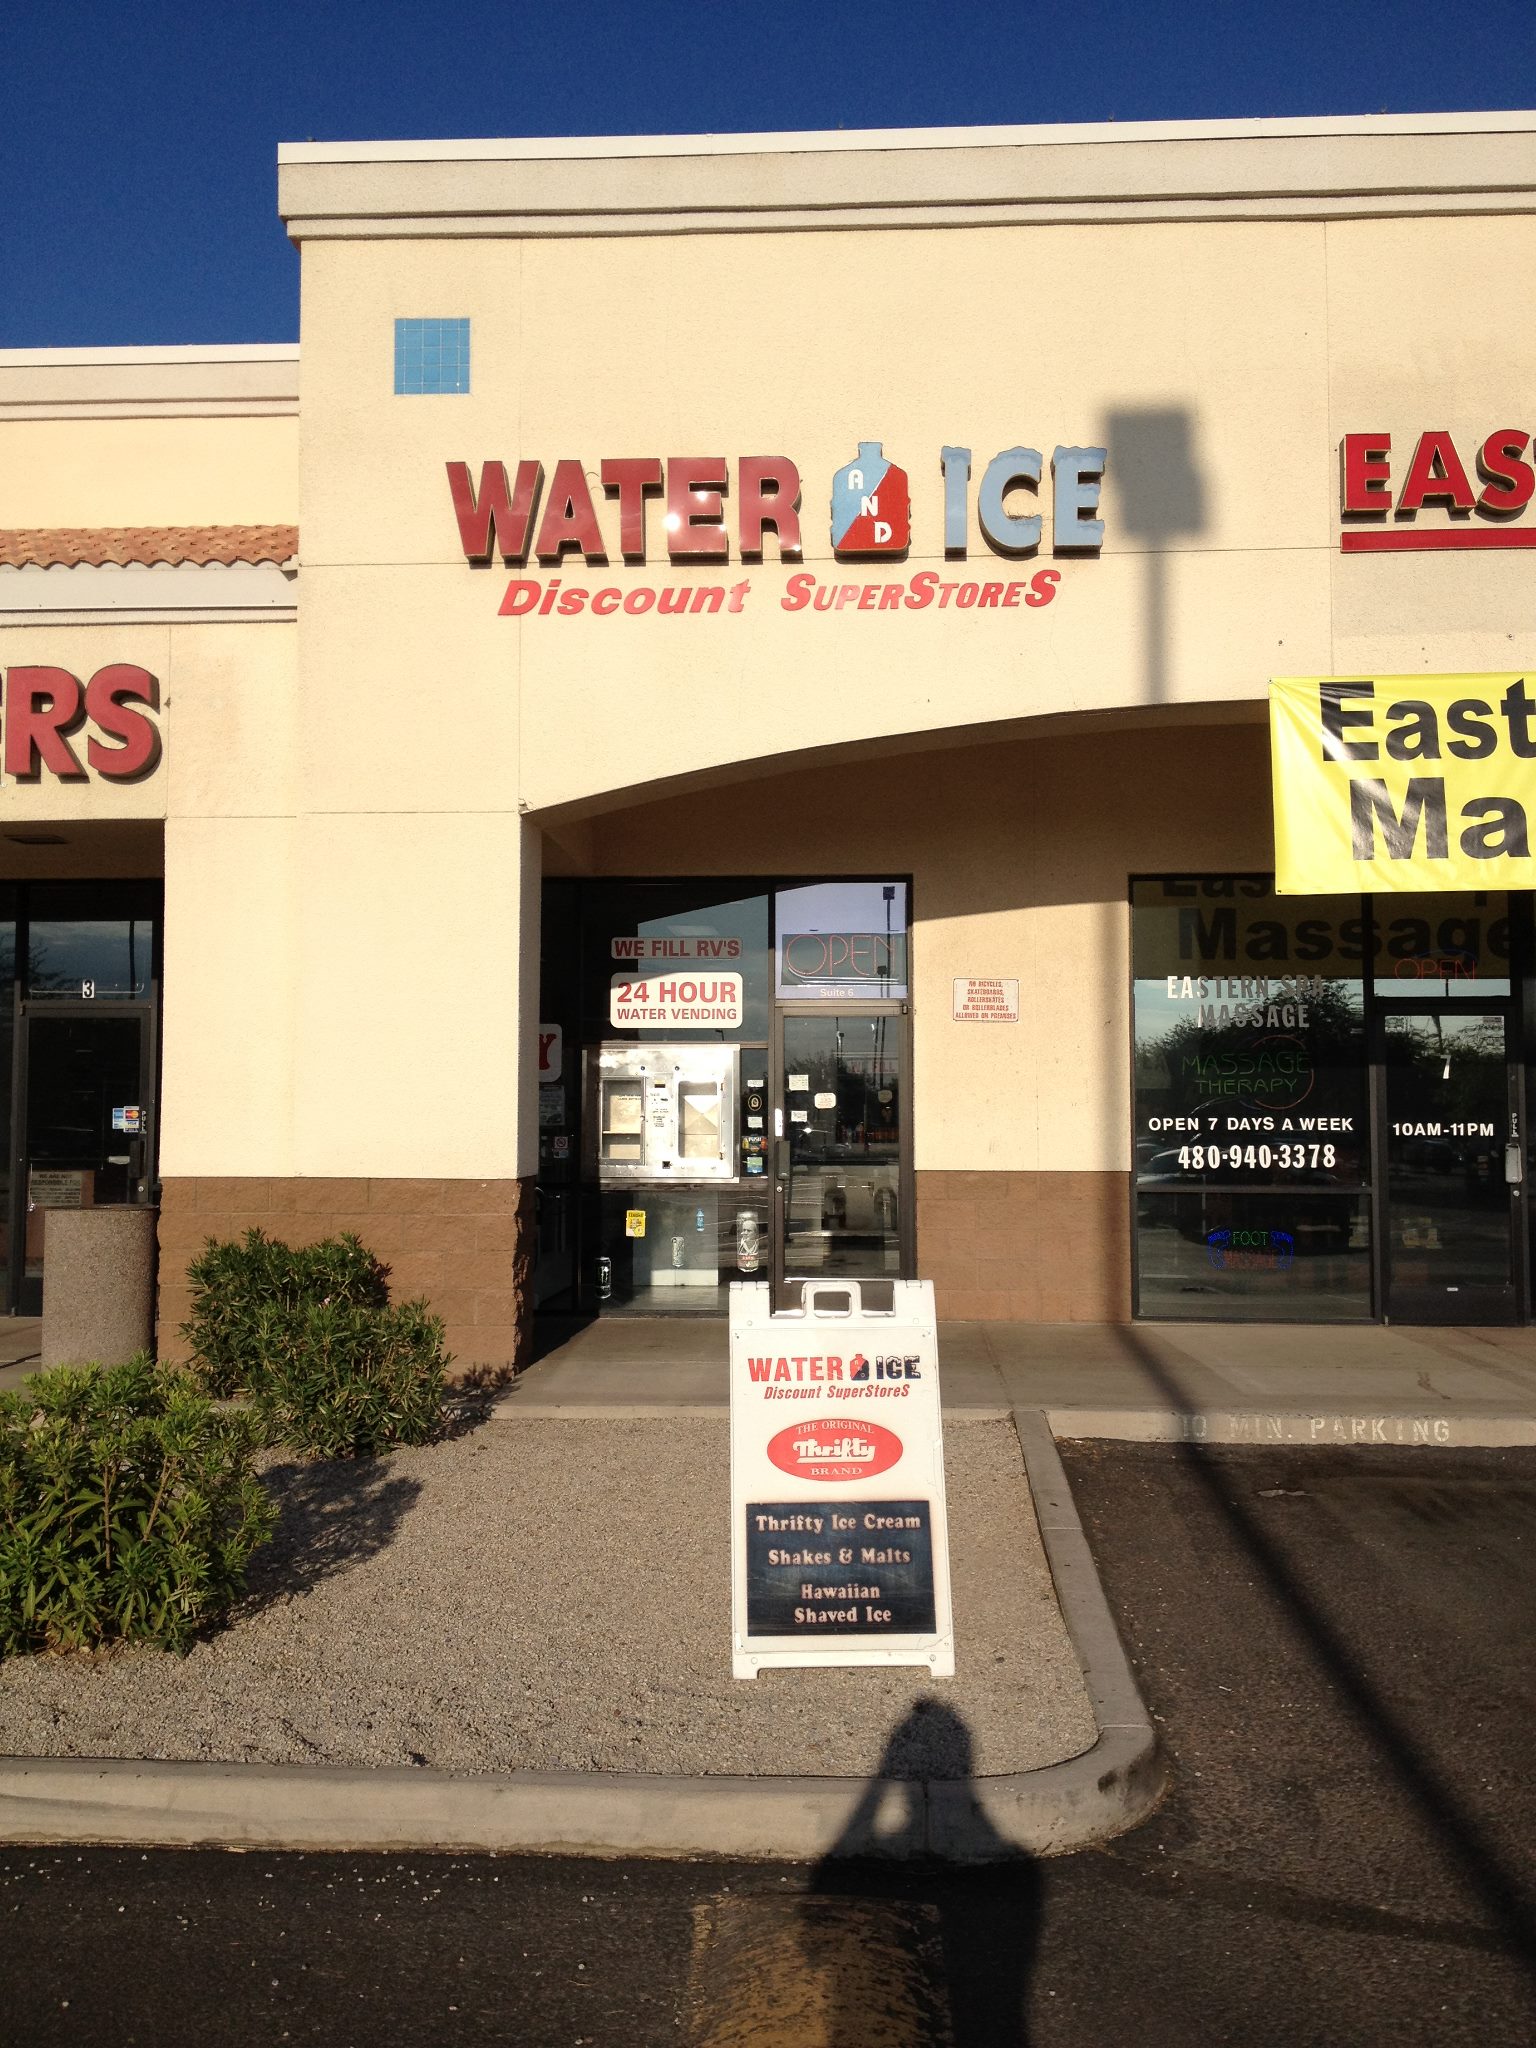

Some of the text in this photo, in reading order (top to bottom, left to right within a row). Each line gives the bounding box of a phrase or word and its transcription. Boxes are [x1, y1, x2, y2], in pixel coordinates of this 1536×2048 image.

[1342, 428, 1536, 518] EAS
[445, 444, 1107, 565] WATER AND ICE
[497, 576, 752, 617] Discount
[0, 662, 162, 785] RS
[614, 939, 741, 958] WE FILL RV'S
[785, 934, 896, 977] OPEN
[1394, 957, 1478, 984] OPEN
[83, 980, 94, 998] 3
[617, 981, 737, 1003] 24 HOUR
[819, 988, 854, 998] Suite 6
[1167, 974, 1326, 999] EASTERN SPA
[616, 1008, 738, 1020] WATER VENDING
[1197, 1004, 1310, 1029] MASSAGE
[1182, 1051, 1311, 1076] MASSAGE
[1440, 1055, 1452, 1079] 7
[1195, 1078, 1298, 1095] THERAPY
[1148, 1117, 1354, 1131] OPEN 7 DAYS A WEEK
[1392, 1122, 1495, 1137] 10AM-11PM
[1178, 1144, 1336, 1170] 480-940-3378
[747, 1356, 844, 1382] WATER
[875, 1355, 922, 1380] ICE
[764, 1384, 911, 1400] Discount SuperStoreS
[795, 1420, 875, 1436] THE ORIGINAL
[1310, 1417, 1451, 1442] PARKING
[792, 1437, 876, 1464] Thrifty
[811, 1467, 863, 1476] BRAND
[755, 1513, 922, 1534] Thrifty Ice Cream
[768, 1547, 912, 1565] Shakes & Malts
[801, 1582, 881, 1600] Hawaiian
[794, 1605, 893, 1624] Shaved Ice
